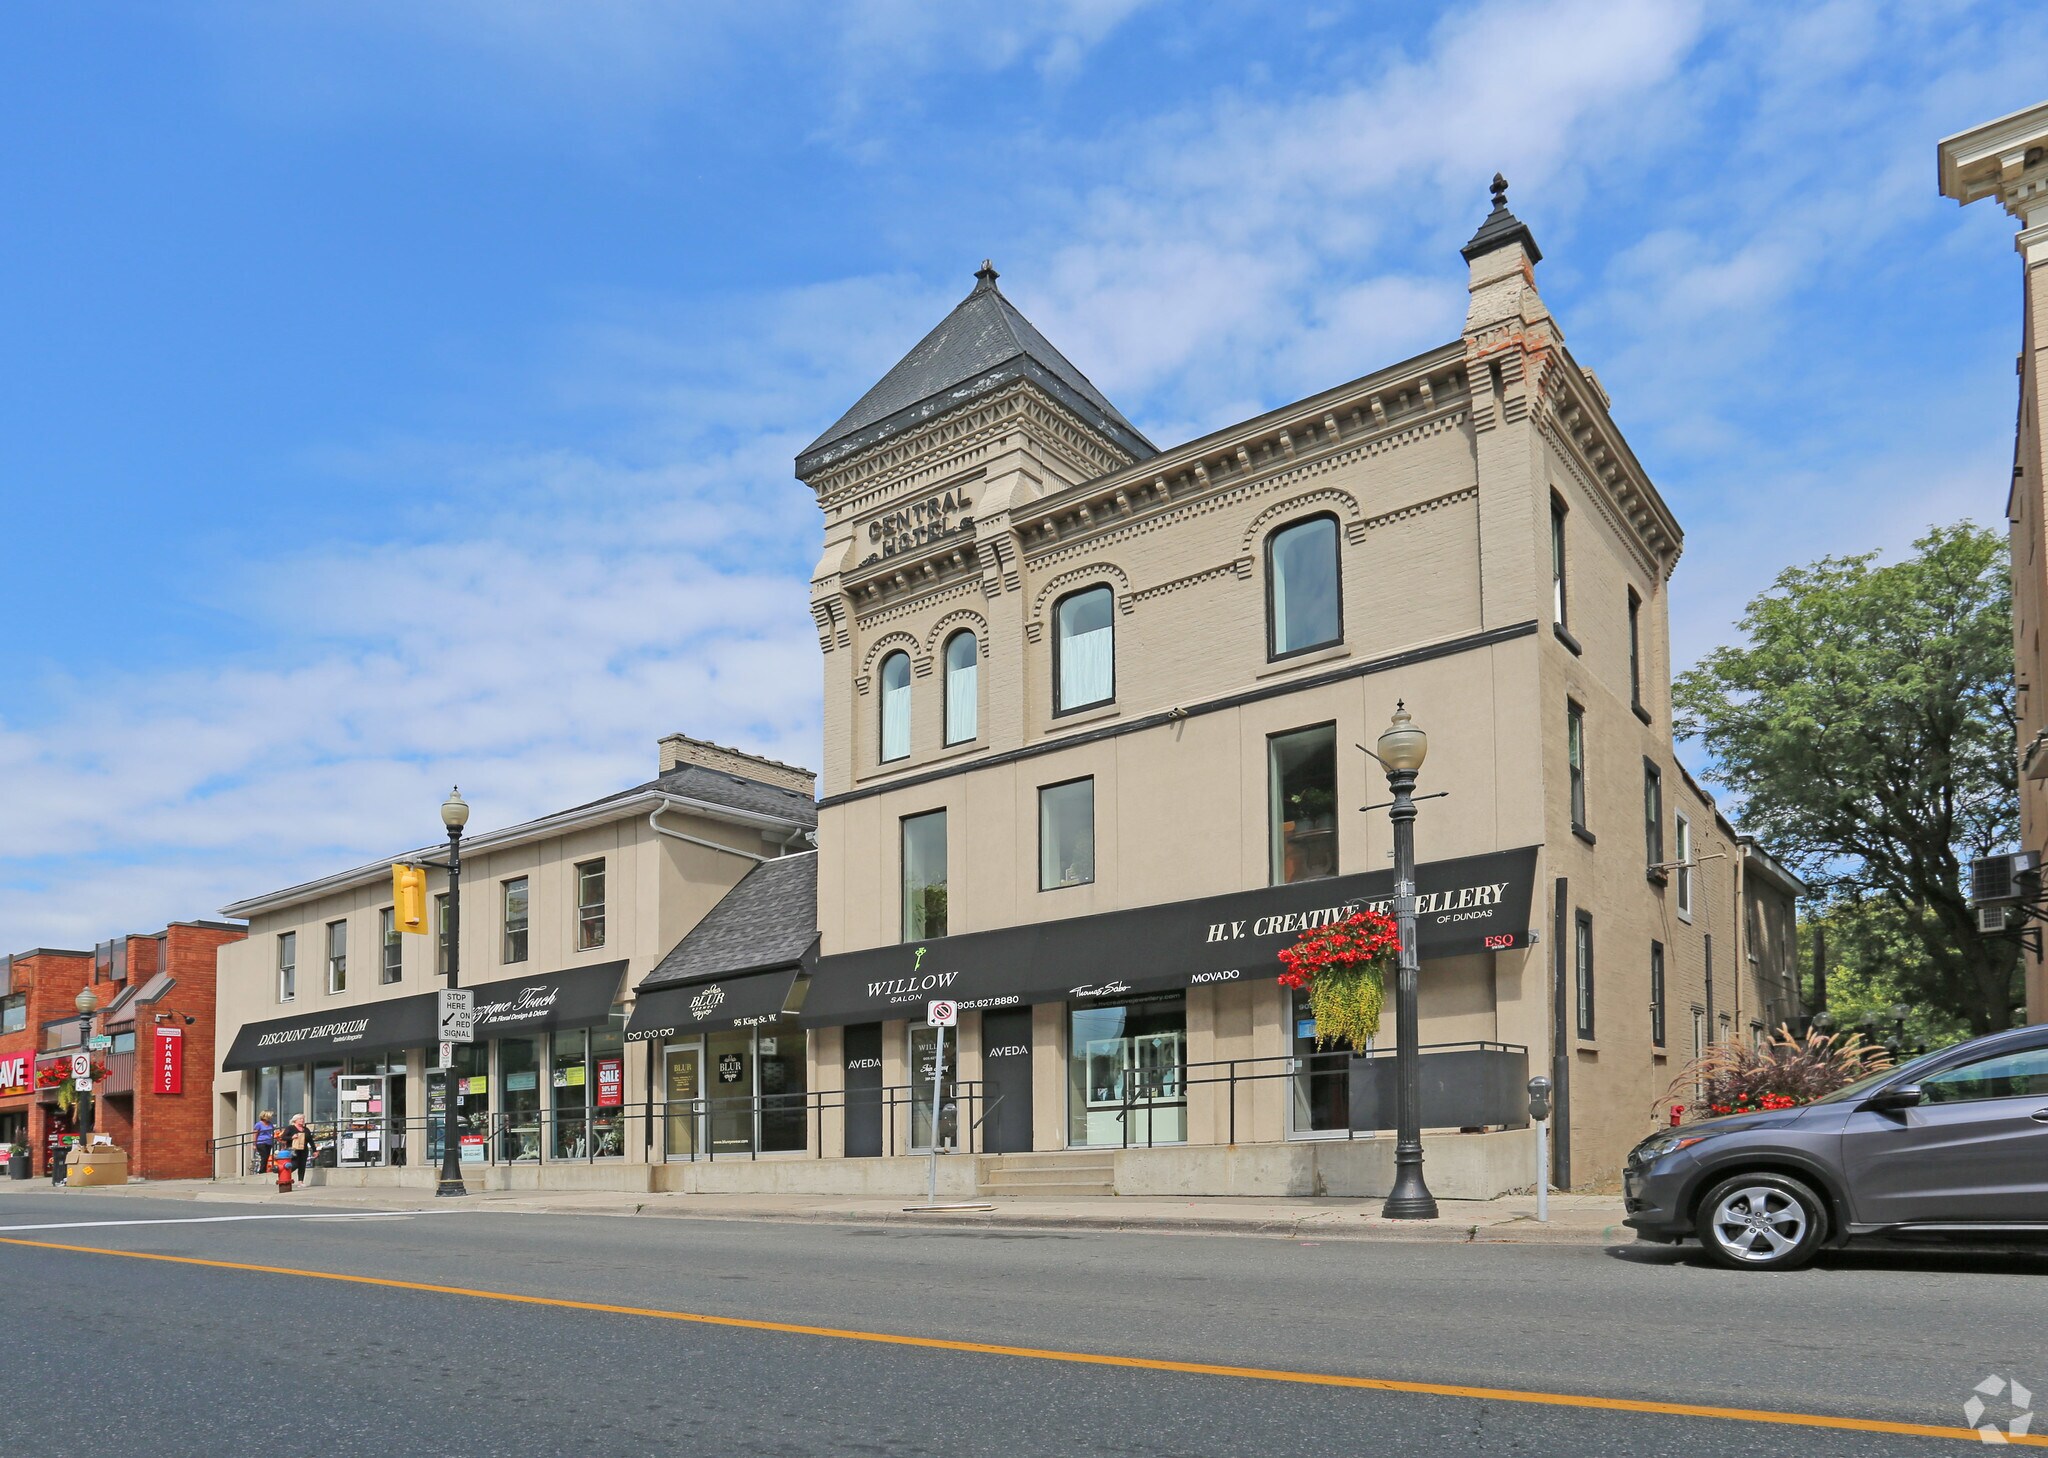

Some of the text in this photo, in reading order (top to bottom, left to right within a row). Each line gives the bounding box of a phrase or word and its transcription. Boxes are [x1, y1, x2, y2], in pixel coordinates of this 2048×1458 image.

[869, 487, 972, 541] CENTRAL
[883, 517, 956, 559] HOTEL
[1206, 920, 1245, 943] H.V.
[1368, 882, 1509, 916] EELLERY
[1437, 909, 1493, 924] OF DUNDAS
[1485, 934, 1514, 947] ESQ
[1191, 969, 1240, 984] MOVADO
[867, 971, 959, 997] WILLOW
[1069, 980, 1131, 997] Thomas Sabo
[447, 993, 466, 1001] STOP
[512, 985, 559, 1011] Touch
[689, 992, 725, 1008] BLUR
[890, 993, 923, 1004] SALON
[957, 995, 1019, 1010] 905.627.8880
[447, 1002, 466, 1010] HERE
[460, 1012, 470, 1020] ON
[511, 1012, 527, 1020] Design
[734, 1018, 742, 1027] 95
[743, 1017, 758, 1026] King
[456, 1020, 471, 1028] RED
[257, 1019, 369, 1046] DISCOUNT EMPORIUM
[444, 1029, 471, 1038] SIGNAL
[918, 1042, 950, 1051] WILLW
[989, 1045, 1029, 1058] AVEDA
[164, 1037, 173, 1091] PHARMACY
[673, 1063, 692, 1072] BLUR
[719, 1061, 742, 1072] BLUR
[848, 1058, 882, 1070] AVEDA
[0, 1058, 24, 1088] AVE
[599, 1069, 620, 1083] SALE
